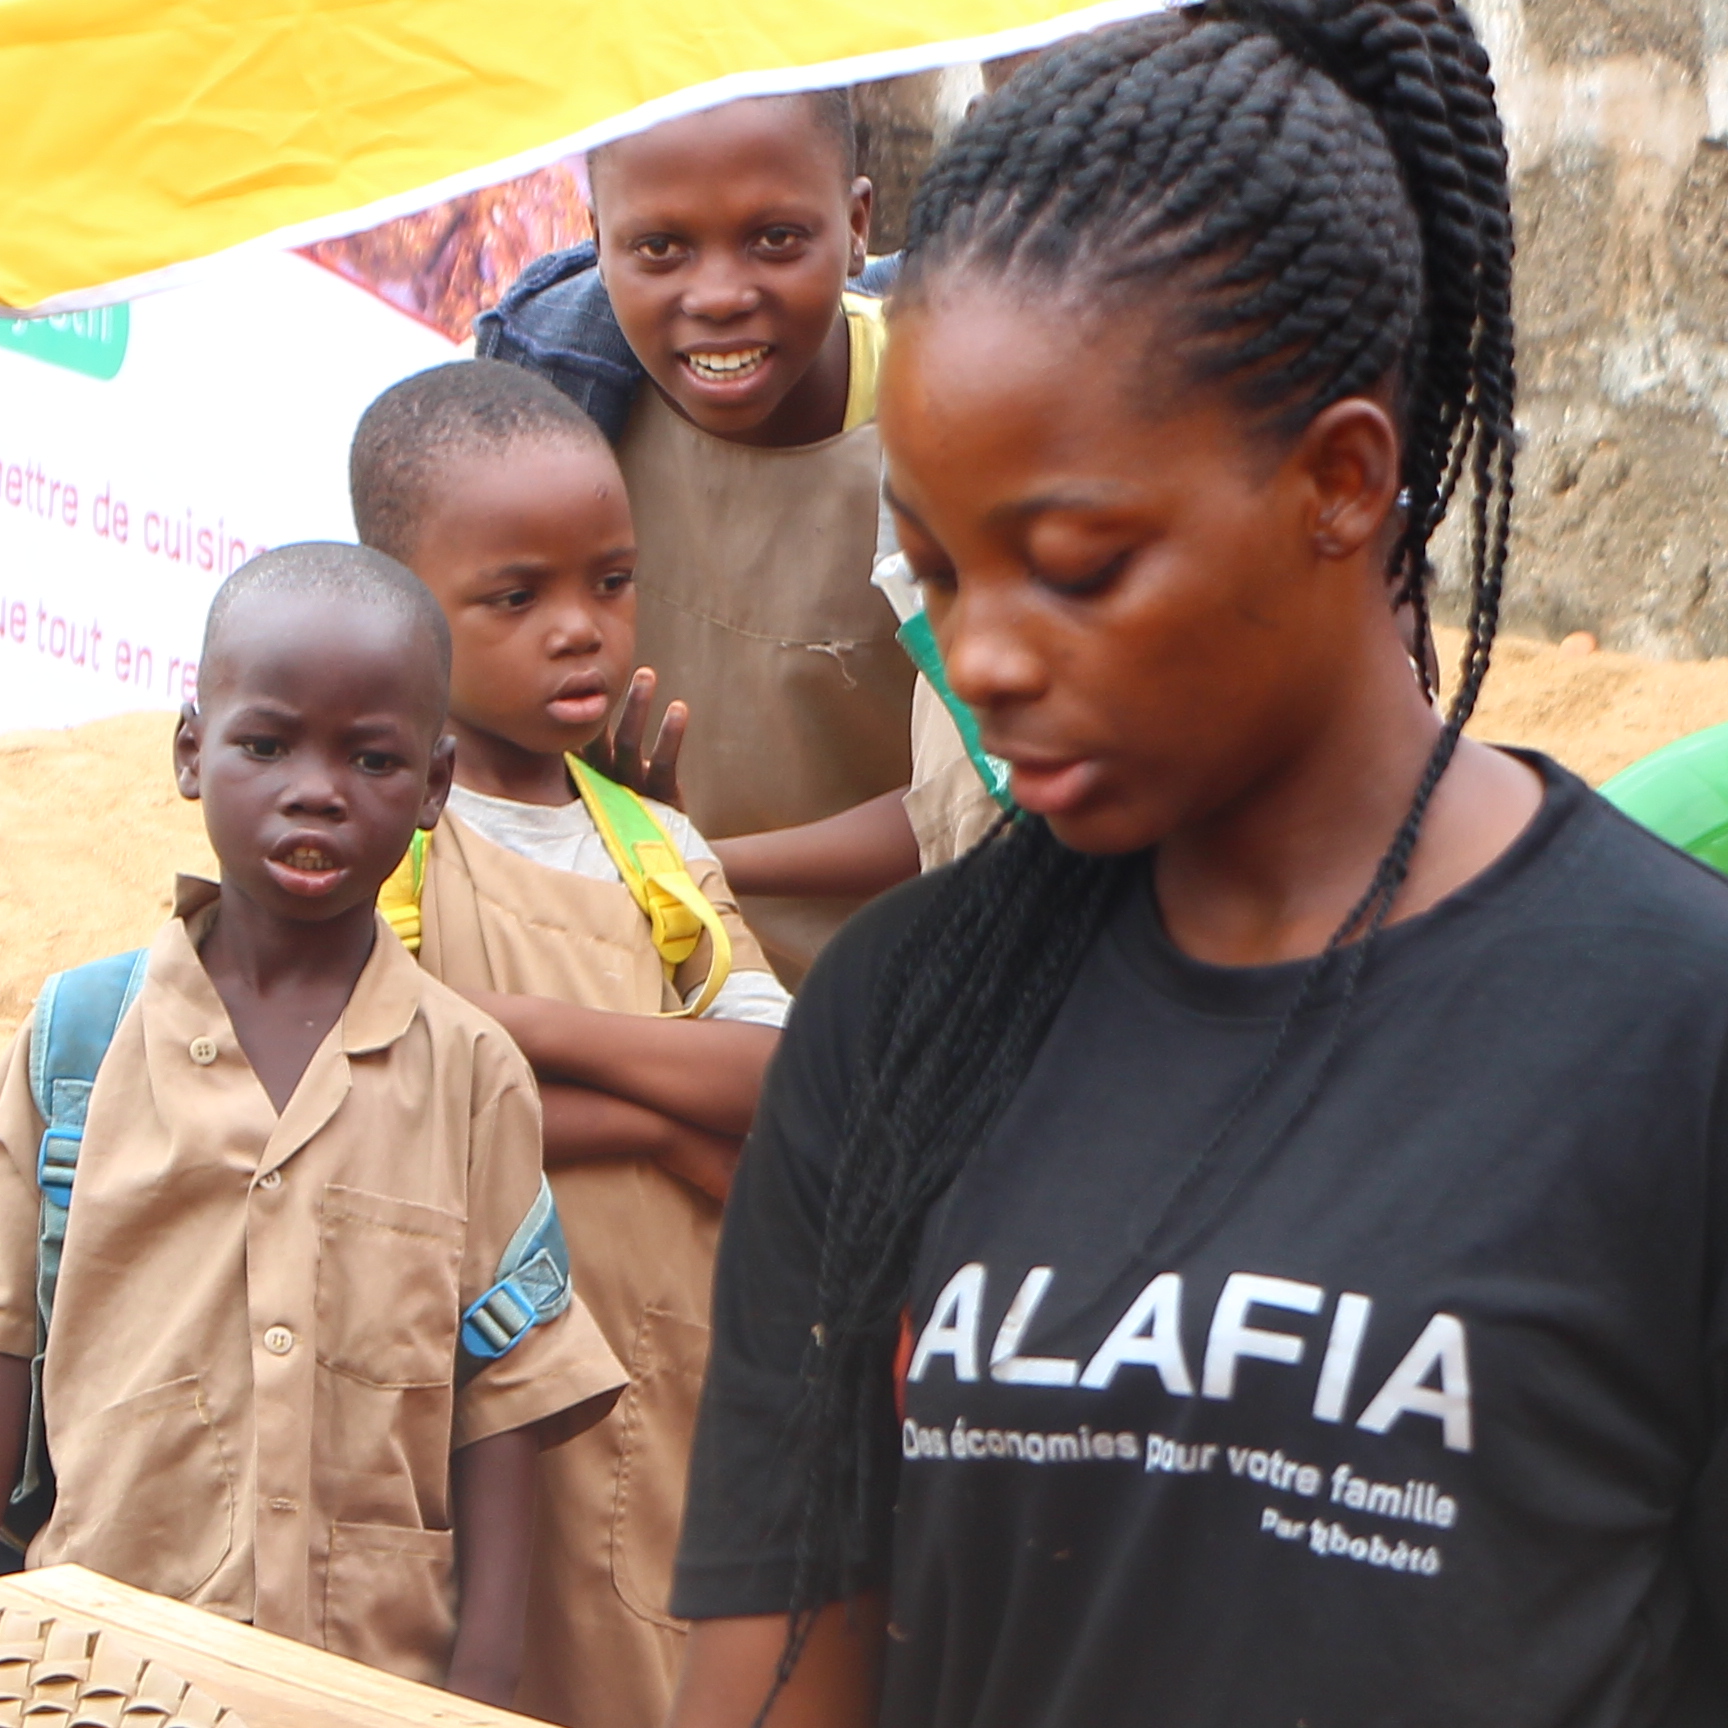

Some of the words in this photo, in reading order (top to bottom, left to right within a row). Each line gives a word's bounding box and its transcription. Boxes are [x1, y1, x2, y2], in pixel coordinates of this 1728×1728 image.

[92, 480, 129, 543] de
[37, 600, 103, 673] tout
[115, 636, 153, 690] en
[907, 1262, 1472, 1453] ALAFIA
[902, 1418, 948, 1461] Des
[950, 1415, 1139, 1464] économies
[1144, 1430, 1219, 1474] pour
[1227, 1446, 1323, 1497] votre
[1330, 1463, 1458, 1529] famille
[1260, 1506, 1306, 1541] Par
